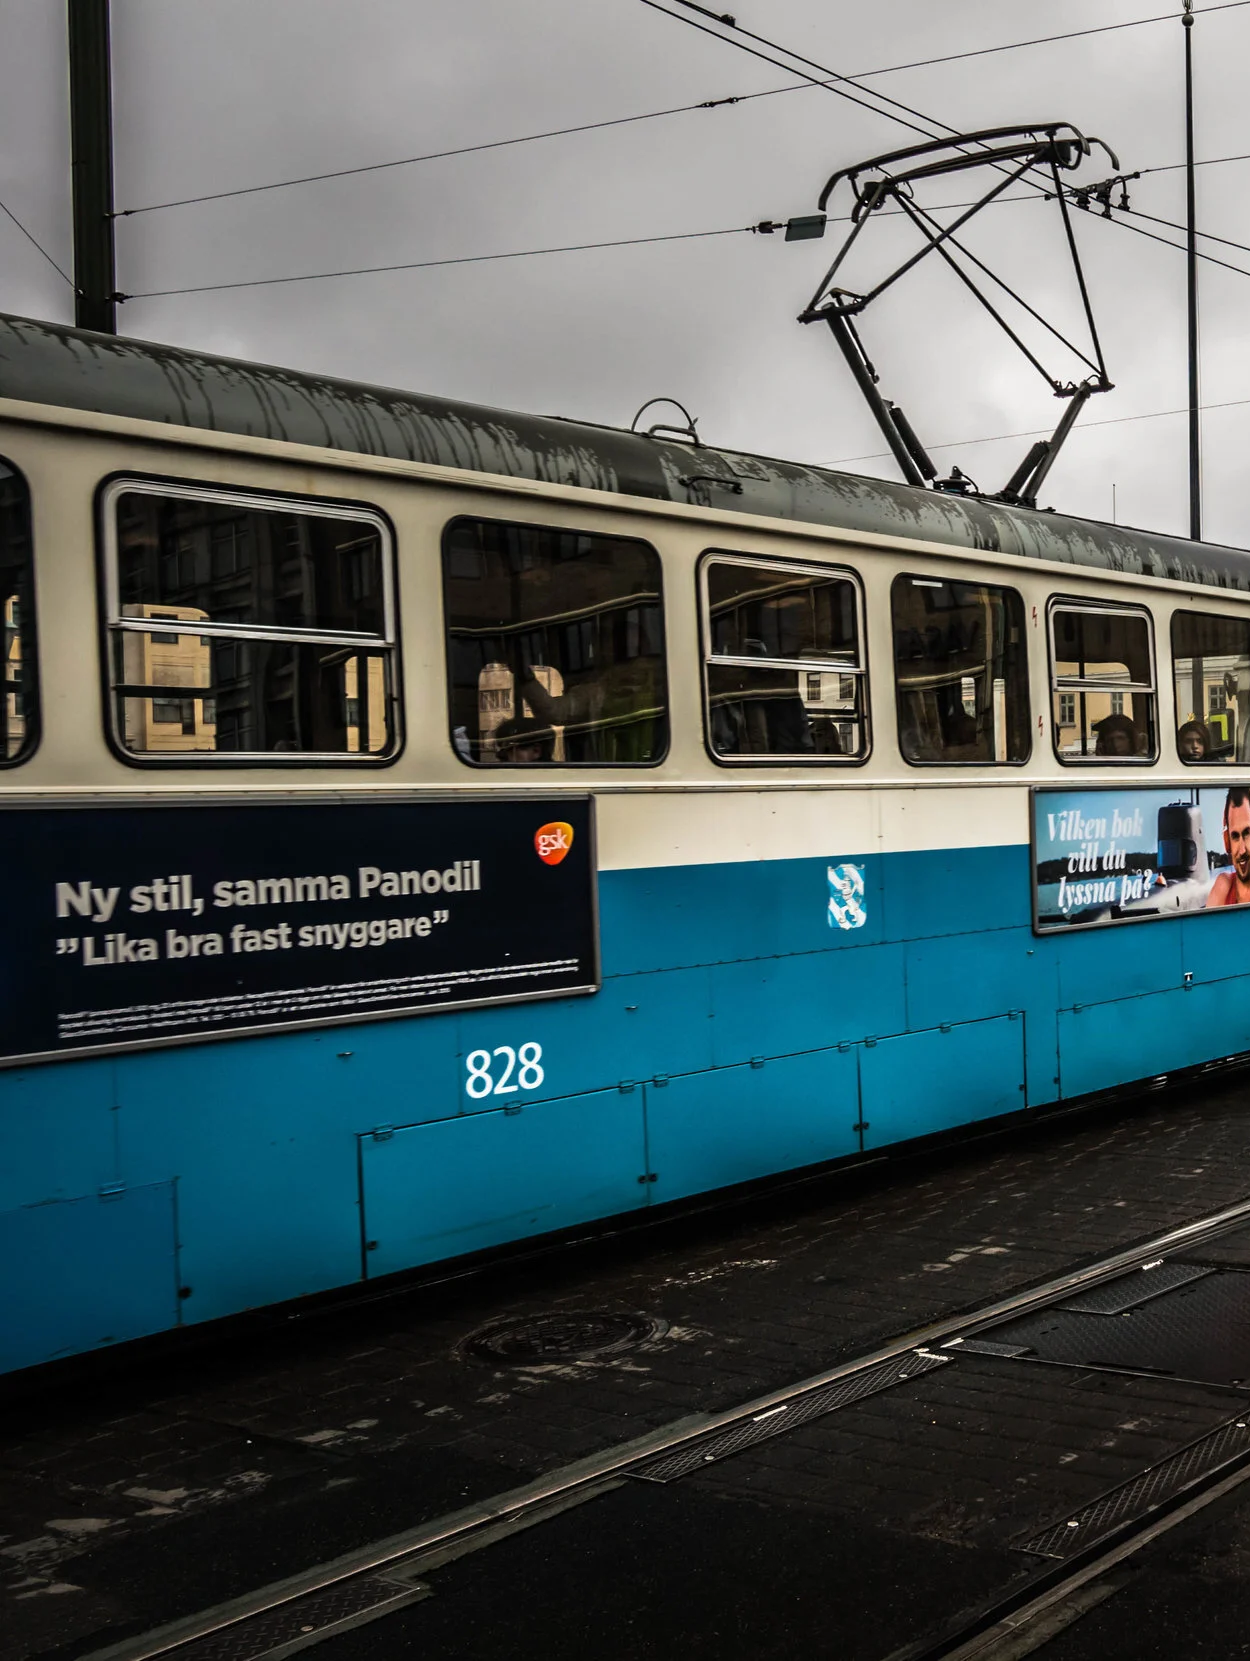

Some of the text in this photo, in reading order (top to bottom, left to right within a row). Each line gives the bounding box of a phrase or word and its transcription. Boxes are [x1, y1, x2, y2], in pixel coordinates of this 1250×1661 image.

[538, 829, 569, 857] gsk
[1047, 807, 1144, 842] Vilken bok
[1068, 842, 1126, 874] vill du
[55, 860, 481, 922] Ny stil, samma Panodil
[1058, 868, 1152, 913] lyssna på?
[55, 910, 449, 967] ”Lika bra fast snyggare”
[465, 1041, 545, 1099] 828
